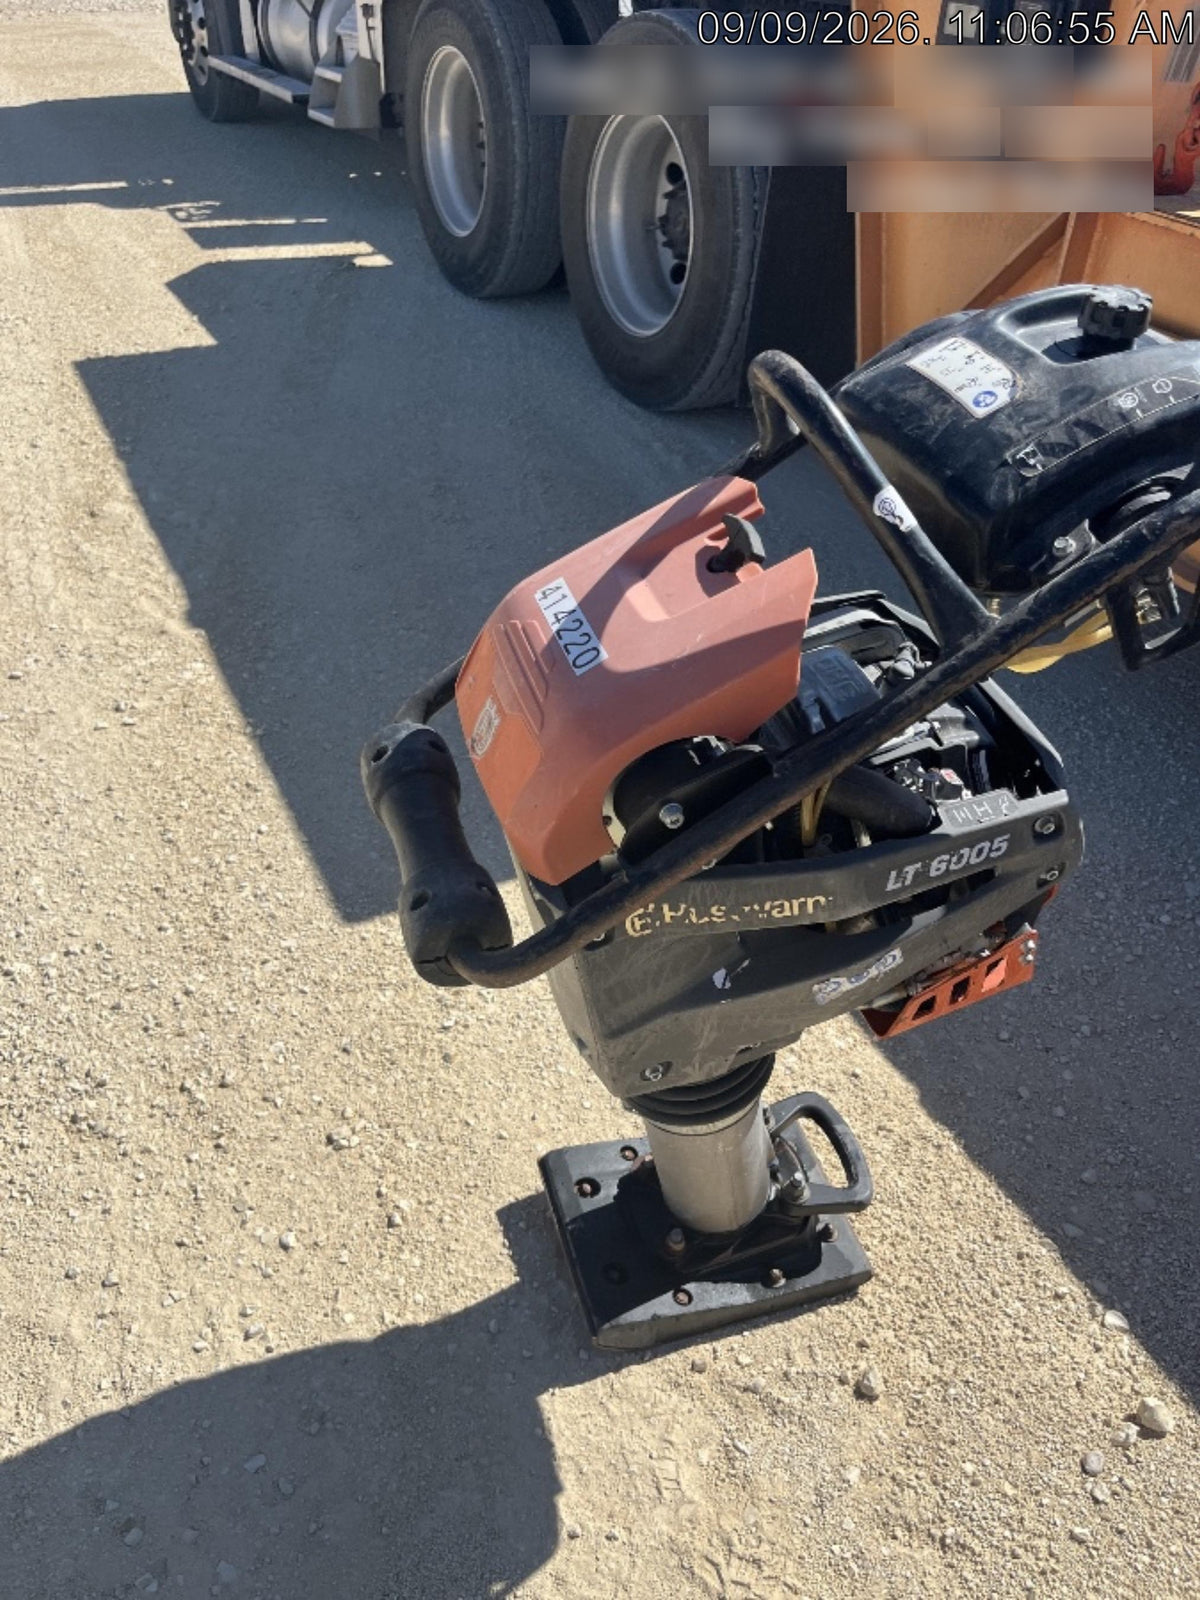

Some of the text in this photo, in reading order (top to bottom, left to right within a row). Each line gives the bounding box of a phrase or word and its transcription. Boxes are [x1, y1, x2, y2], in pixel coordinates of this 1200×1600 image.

[537, 584, 603, 670] 414220
[885, 833, 1010, 891] LT 6005
